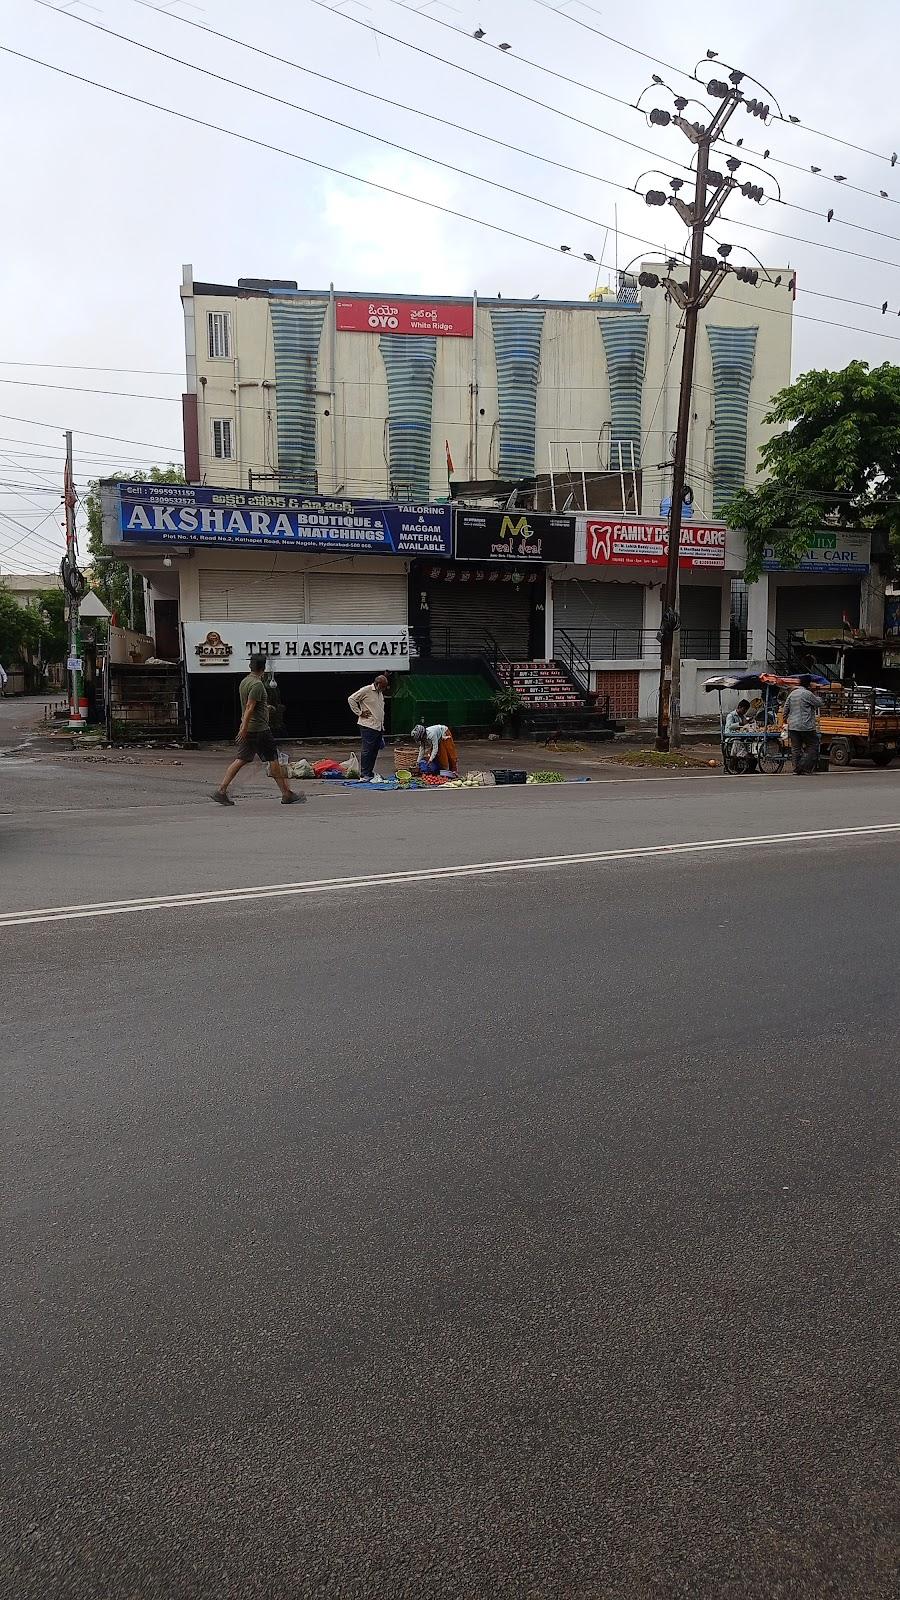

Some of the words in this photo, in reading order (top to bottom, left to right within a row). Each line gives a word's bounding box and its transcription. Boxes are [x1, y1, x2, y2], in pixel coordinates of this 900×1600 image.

[368, 316, 399, 329] OYO
[432, 322, 453, 330] Ridge
[398, 505, 445, 514] TAILORING
[127, 505, 294, 536] AKSHARA
[298, 514, 371, 528] BOUTIQUE
[298, 527, 384, 540] MATCHINGS
[402, 524, 440, 533] MAGGAM
[400, 534, 443, 542] MATERIAL
[614, 525, 653, 541] FAMILY
[697, 529, 725, 545] CARE
[398, 543, 445, 551] AVAILABLE
[824, 550, 858, 561] CARE
[246, 642, 280, 656] THE
[368, 637, 409, 655] CAFÉ
